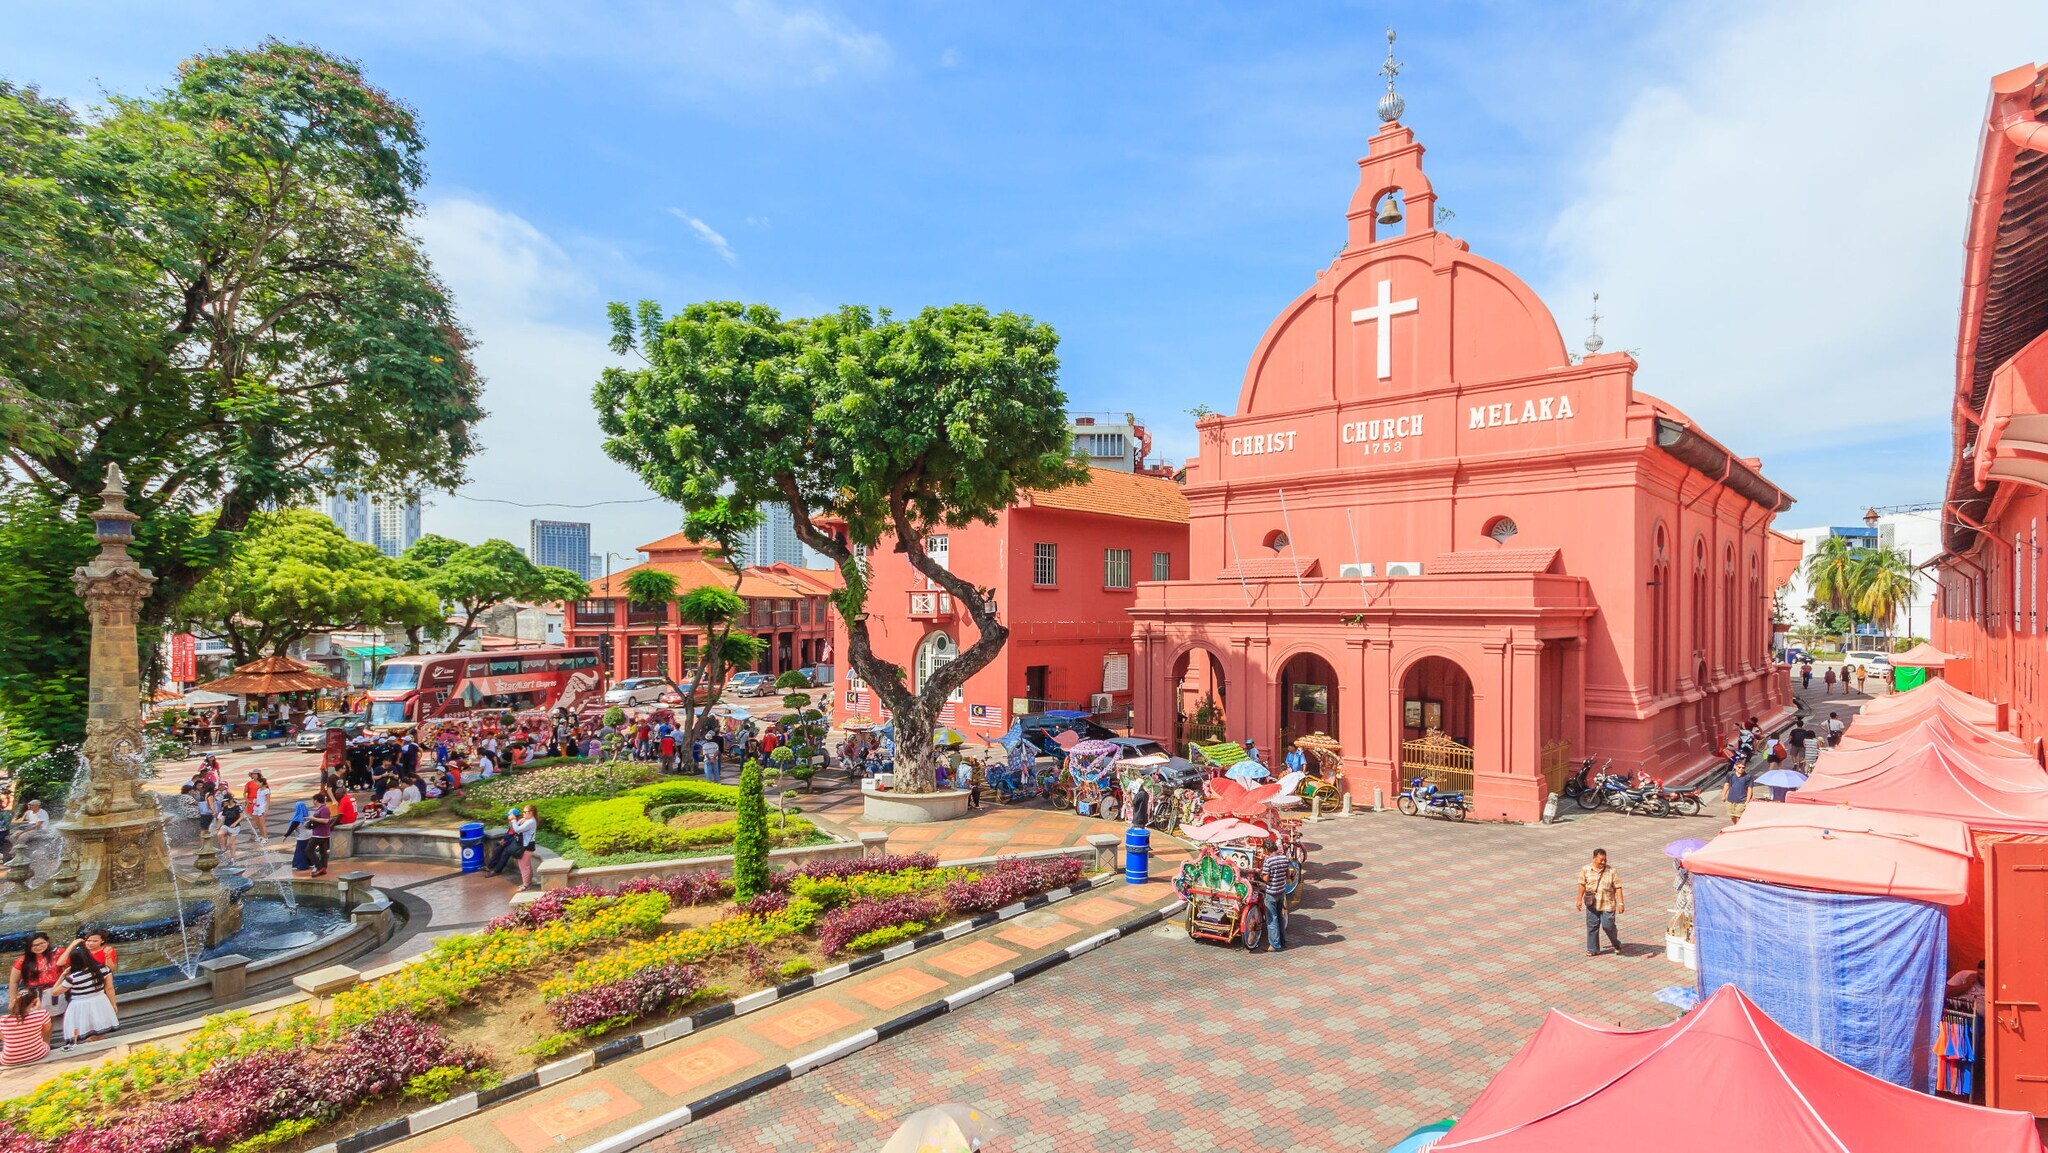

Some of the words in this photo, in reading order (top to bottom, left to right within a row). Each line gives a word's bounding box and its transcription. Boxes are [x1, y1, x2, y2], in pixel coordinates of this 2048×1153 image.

[1231, 430, 1297, 456] CHRIST
[1342, 414, 1424, 443] CHURCH
[1469, 395, 1574, 430] MELAKA
[1363, 441, 1402, 455] 1753
